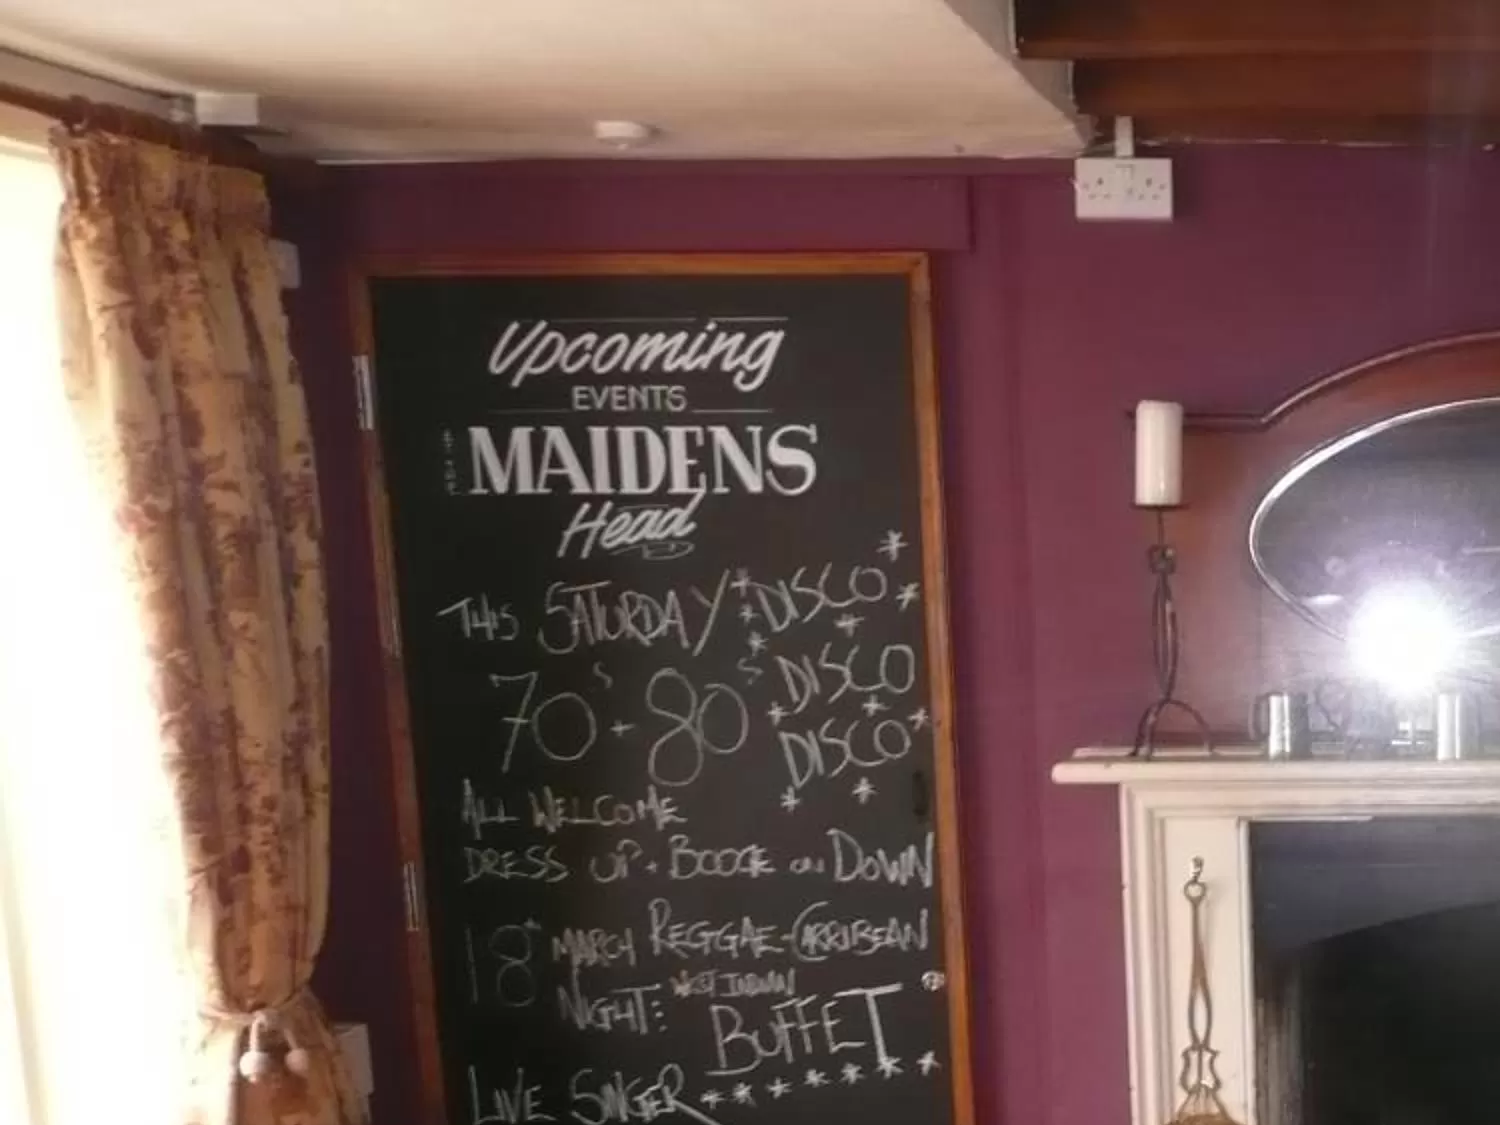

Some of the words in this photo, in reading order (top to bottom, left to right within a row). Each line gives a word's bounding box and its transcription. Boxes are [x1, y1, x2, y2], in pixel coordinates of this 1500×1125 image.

[488, 319, 785, 392] Upcoming
[571, 385, 688, 412] EVENTS
[467, 423, 819, 497] MAIDENS
[557, 487, 707, 560] Head
[752, 562, 888, 634] DISCO
[774, 641, 916, 715] DISCO
[779, 717, 913, 788] DISCO
[462, 777, 521, 841] ALL
[527, 784, 689, 833] WELCOME
[463, 845, 569, 883] DRESS
[826, 827, 936, 888] DOWN
[552, 926, 638, 968] MARCH
[706, 983, 903, 1076] BUFFET
[469, 1064, 557, 1125] LIVE
